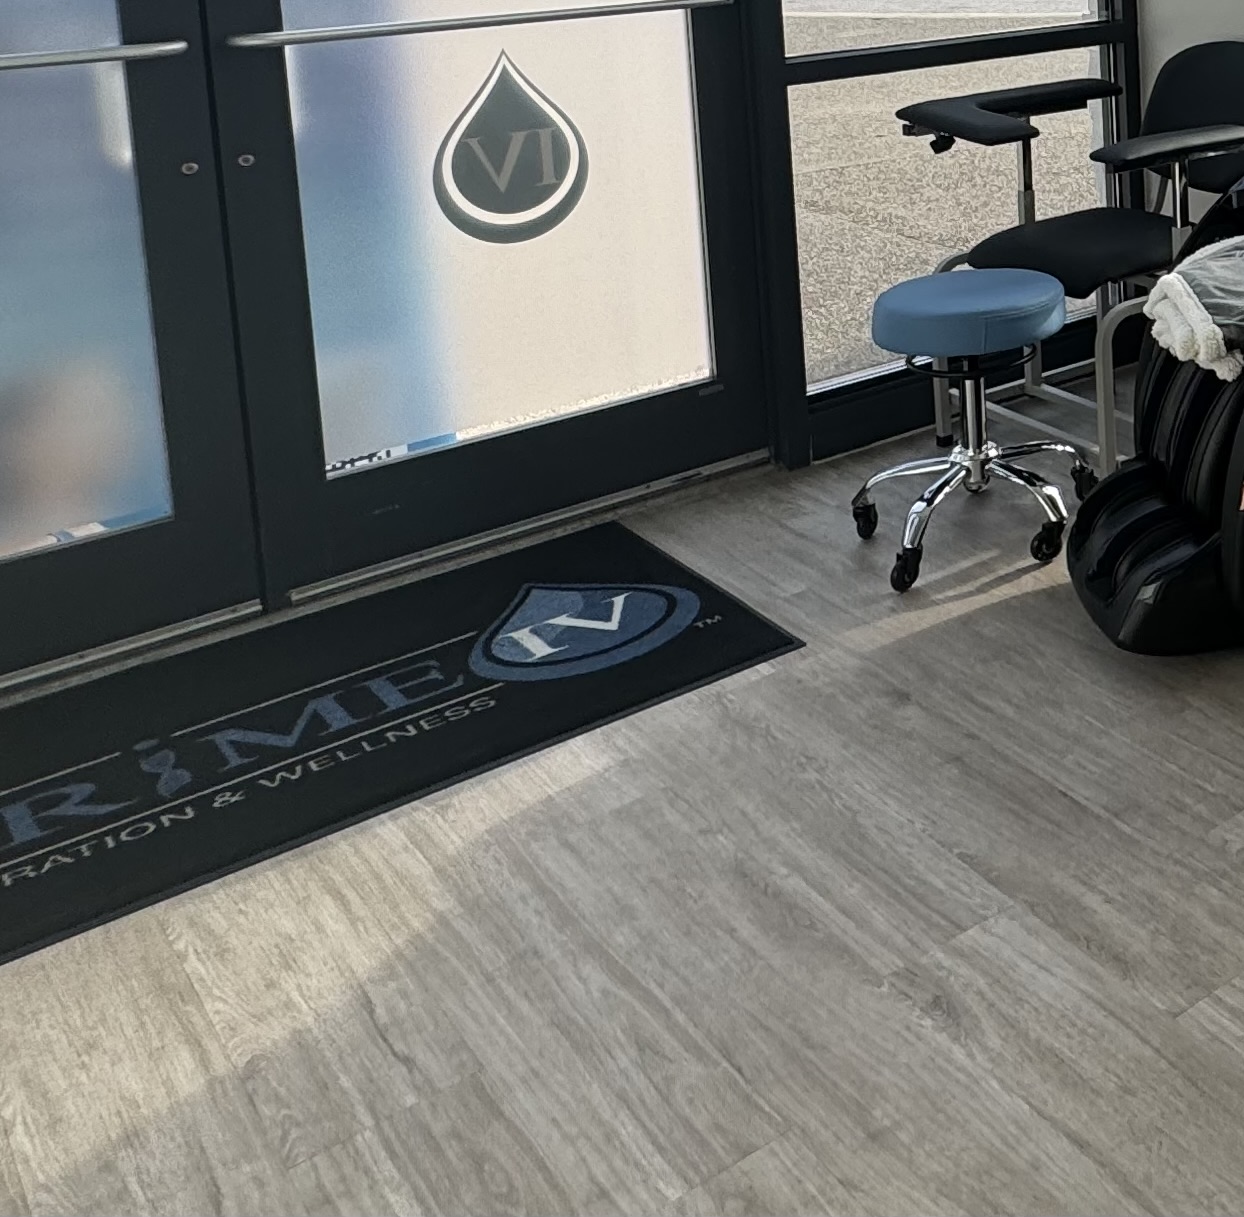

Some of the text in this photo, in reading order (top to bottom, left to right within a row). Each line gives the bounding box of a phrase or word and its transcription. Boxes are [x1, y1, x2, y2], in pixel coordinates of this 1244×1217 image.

[498, 591, 633, 663] IV
[211, 788, 247, 808] &
[257, 695, 497, 788] WELLNESS
